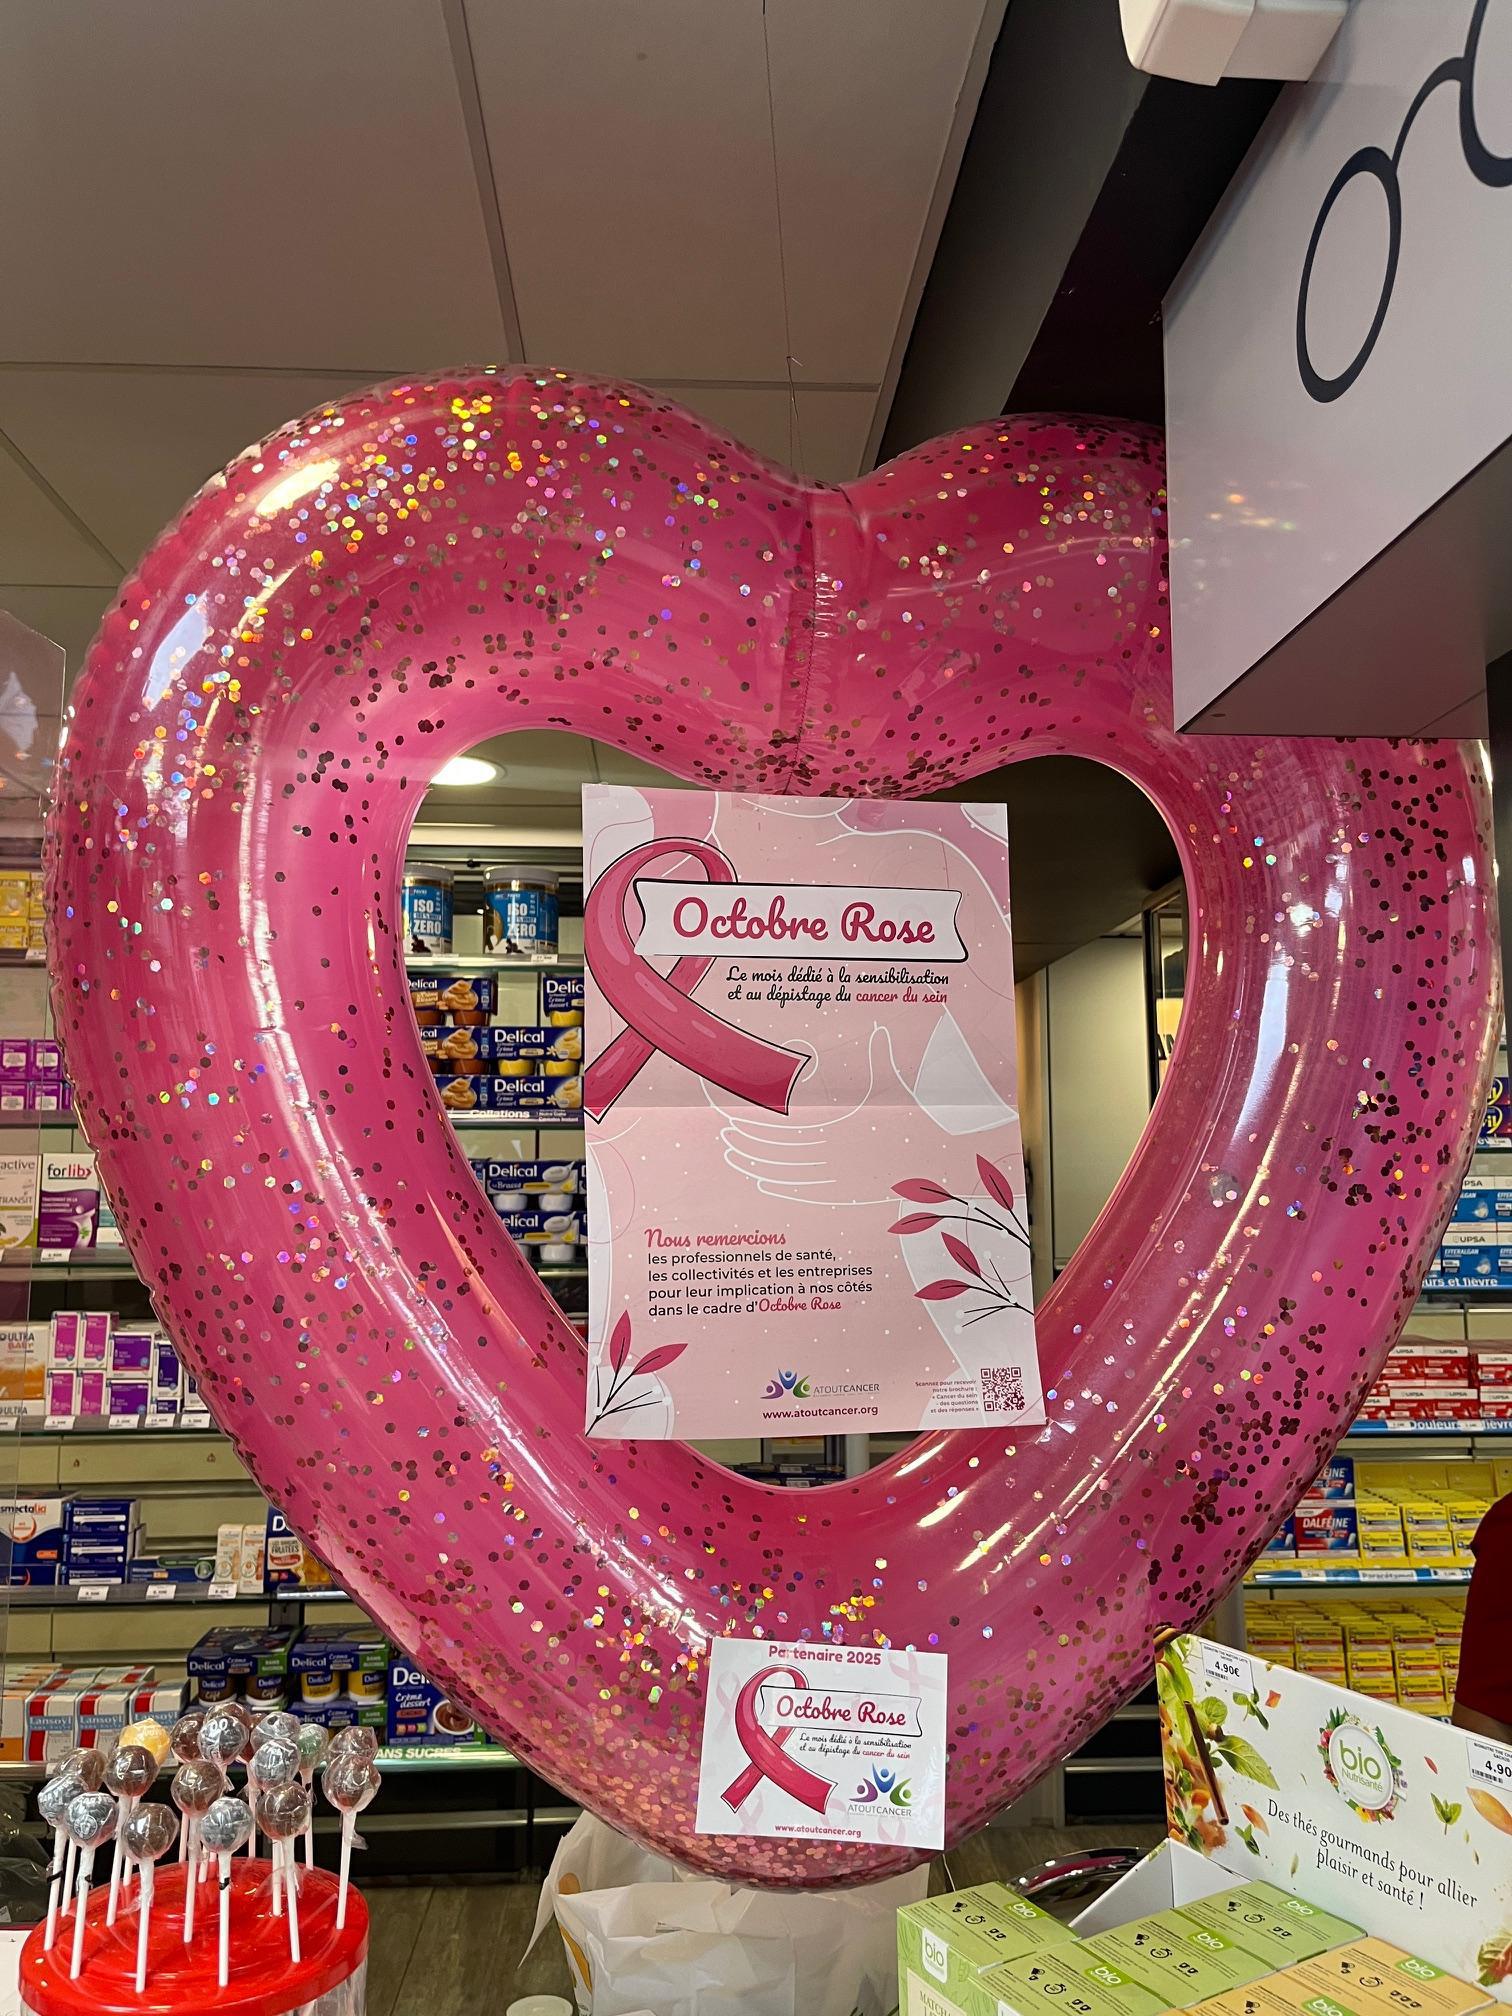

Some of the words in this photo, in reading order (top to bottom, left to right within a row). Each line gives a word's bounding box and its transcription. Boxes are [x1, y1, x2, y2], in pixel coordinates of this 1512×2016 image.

[413, 899, 434, 912] ISO
[507, 903, 528, 916] ISO
[413, 920, 441, 934] ZERO
[672, 895, 829, 941] Octobre
[840, 900, 936, 945] Rose
[507, 923, 536, 937] ZERO
[726, 966, 747, 982] Le
[752, 972, 782, 982] mois
[788, 966, 822, 982] dédié
[827, 968, 834, 982] à
[839, 966, 851, 982] la
[855, 967, 949, 985] sensibilisation
[728, 985, 741, 1000] et
[746, 991, 761, 1000] au
[767, 984, 831, 1009] dépistage
[836, 985, 851, 1001] du
[856, 992, 898, 1002] cancer
[903, 986, 918, 1003] du
[922, 991, 948, 1003] sein
[495, 1030, 544, 1043] Delical
[495, 1079, 544, 1092] Delical
[489, 1164, 538, 1177] Delical
[502, 1215, 538, 1227] elical
[644, 1229, 691, 1248] Nous
[696, 1230, 786, 1247] remercions
[648, 1253, 667, 1264] les
[672, 1250, 772, 1266] professionnels
[775, 1250, 793, 1261] de
[796, 1249, 836, 1261] santé,
[648, 1271, 667, 1282] les
[671, 1267, 754, 1282] collectivités
[758, 1269, 771, 1279] et
[776, 1266, 794, 1278] les
[798, 1264, 873, 1278] entreprises
[1422, 1278, 1445, 1287] urs
[1448, 1277, 1461, 1287] et
[1464, 1277, 1498, 1287] fièvre
[649, 1288, 681, 1301] pour
[686, 1286, 712, 1297] leur
[717, 1283, 794, 1299] implication
[798, 1282, 805, 1294] à
[810, 1283, 833, 1293] nos
[837, 1281, 873, 1293] côtés
[649, 1304, 683, 1316] dans
[687, 1303, 698, 1315] le
[703, 1301, 742, 1314] cadre
[811, 1297, 841, 1310] Rose
[813, 1384, 880, 1395] ATOUTCANCER
[762, 1405, 879, 1420] www.atoutcancer.org
[1321, 1468, 1345, 1478] EINE
[1303, 1516, 1348, 1528] DALFÉINE
[189, 1661, 225, 1670] Delical
[292, 1657, 326, 1667] Delical
[847, 1652, 882, 1665] 2025
[1215, 1661, 1240, 1677] 4.90€
[299, 1713, 325, 1723] elical
[776, 1695, 852, 1721] Octobre
[858, 1701, 906, 1726] Rose
[30, 1716, 72, 1726] Lansoyl
[80, 1715, 124, 1725] Lansoyl
[800, 1733, 810, 1741] Le
[829, 1734, 847, 1743] dédié
[855, 1736, 860, 1745] la
[863, 1738, 912, 1748] sensibilisation
[377, 1750, 403, 1758] ANS
[799, 1743, 806, 1751] et
[818, 1743, 850, 1758] dépistage
[852, 1746, 860, 1755] du
[886, 1749, 895, 1757] du
[1340, 1740, 1381, 1779] bio
[1342, 1768, 1383, 1792] Nutrisanté
[848, 1804, 912, 1817] ATOUTCANCER
[775, 1824, 861, 1838] www.atoutcancer.org
[1268, 1799, 1290, 1824] Des
[1293, 1812, 1318, 1836] thés
[1320, 1829, 1395, 1871] gourmands
[1399, 1861, 1434, 1887] pour
[1438, 1878, 1478, 1908] allier
[1317, 1848, 1359, 1879] plaisir
[1362, 1871, 1374, 1887] et
[1377, 1879, 1414, 1906] santé
[1419, 1892, 1424, 1910] !
[1013, 1903, 1037, 1918] bio
[1287, 1900, 1314, 1916] bio
[1197, 1932, 1224, 1950] bio
[925, 1937, 944, 1967] bio
[1094, 1966, 1122, 1984] bio
[1405, 1959, 1435, 1978] bio
[1313, 1999, 1343, 2016] bio
